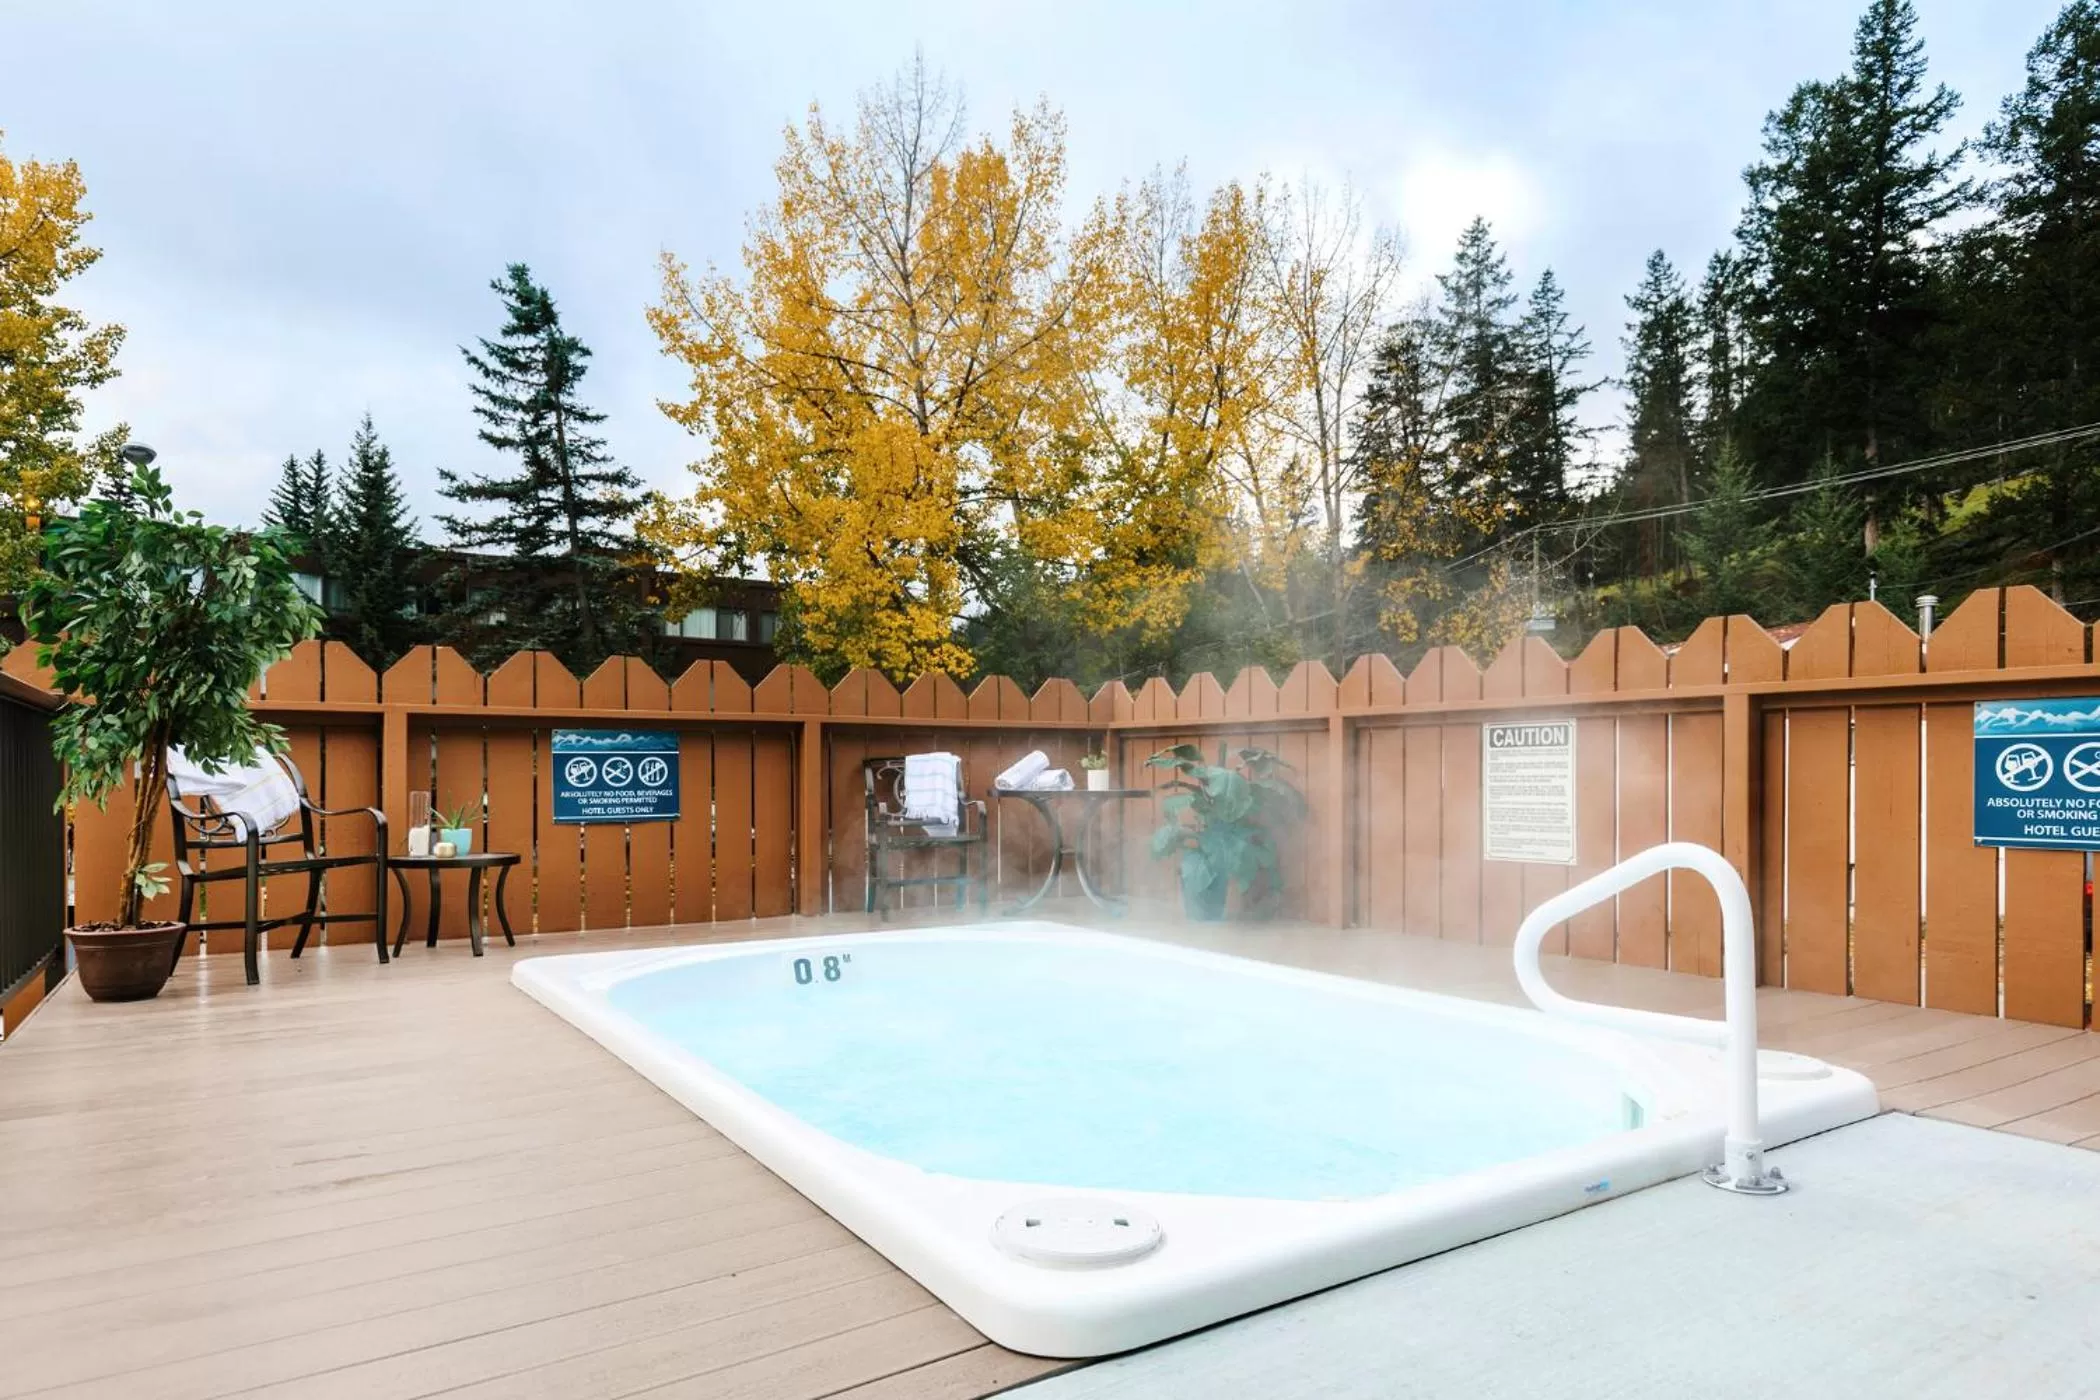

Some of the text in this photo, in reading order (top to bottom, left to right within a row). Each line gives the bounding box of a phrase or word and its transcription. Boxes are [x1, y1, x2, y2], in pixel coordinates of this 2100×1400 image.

[1493, 727, 1565, 746] CAUTION
[636, 789, 673, 797] BEVERAGES
[1987, 797, 2064, 808] ABSOLUTELY
[2066, 798, 2086, 809] NO
[582, 807, 605, 815] HOTEL
[2017, 809, 2098, 820] OR SMOKING
[2024, 825, 2068, 836] HOTEL
